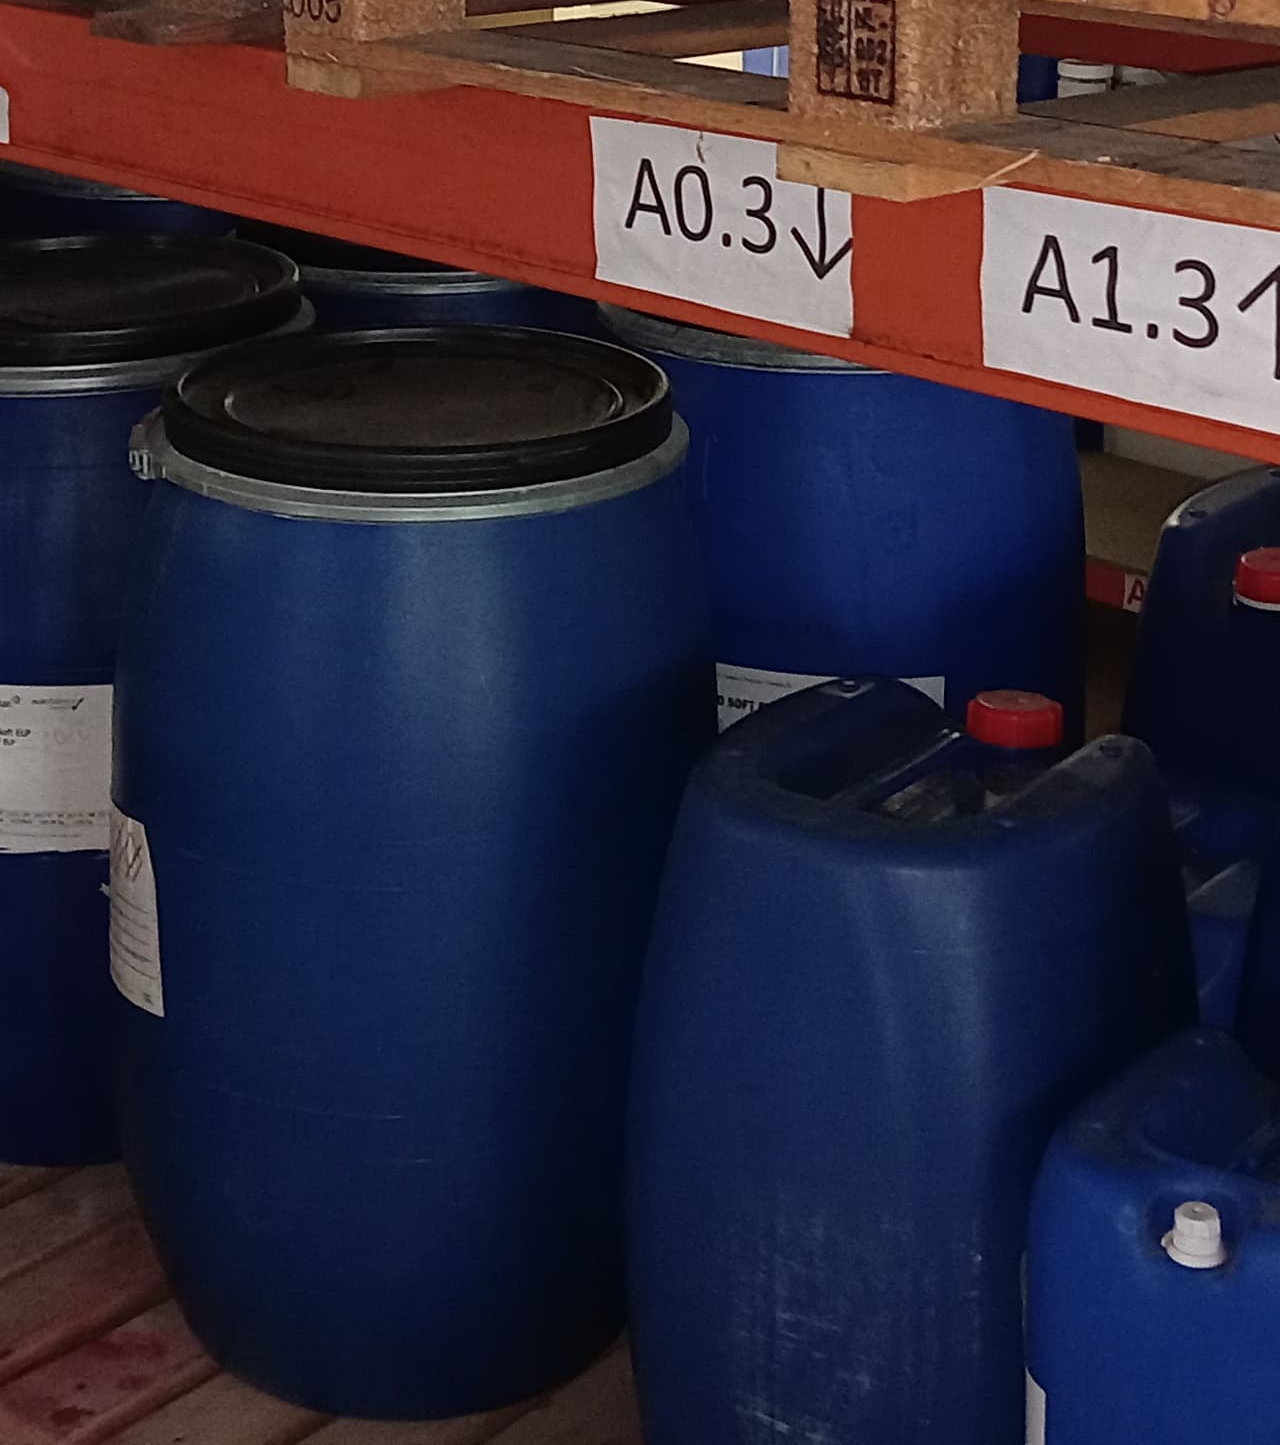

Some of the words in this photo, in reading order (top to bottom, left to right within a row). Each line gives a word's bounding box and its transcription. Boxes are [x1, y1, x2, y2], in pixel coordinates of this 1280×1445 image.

[624, 157, 778, 254] A0.3
[1021, 235, 1221, 350] A1.3
[727, 696, 754, 711] SOFT
